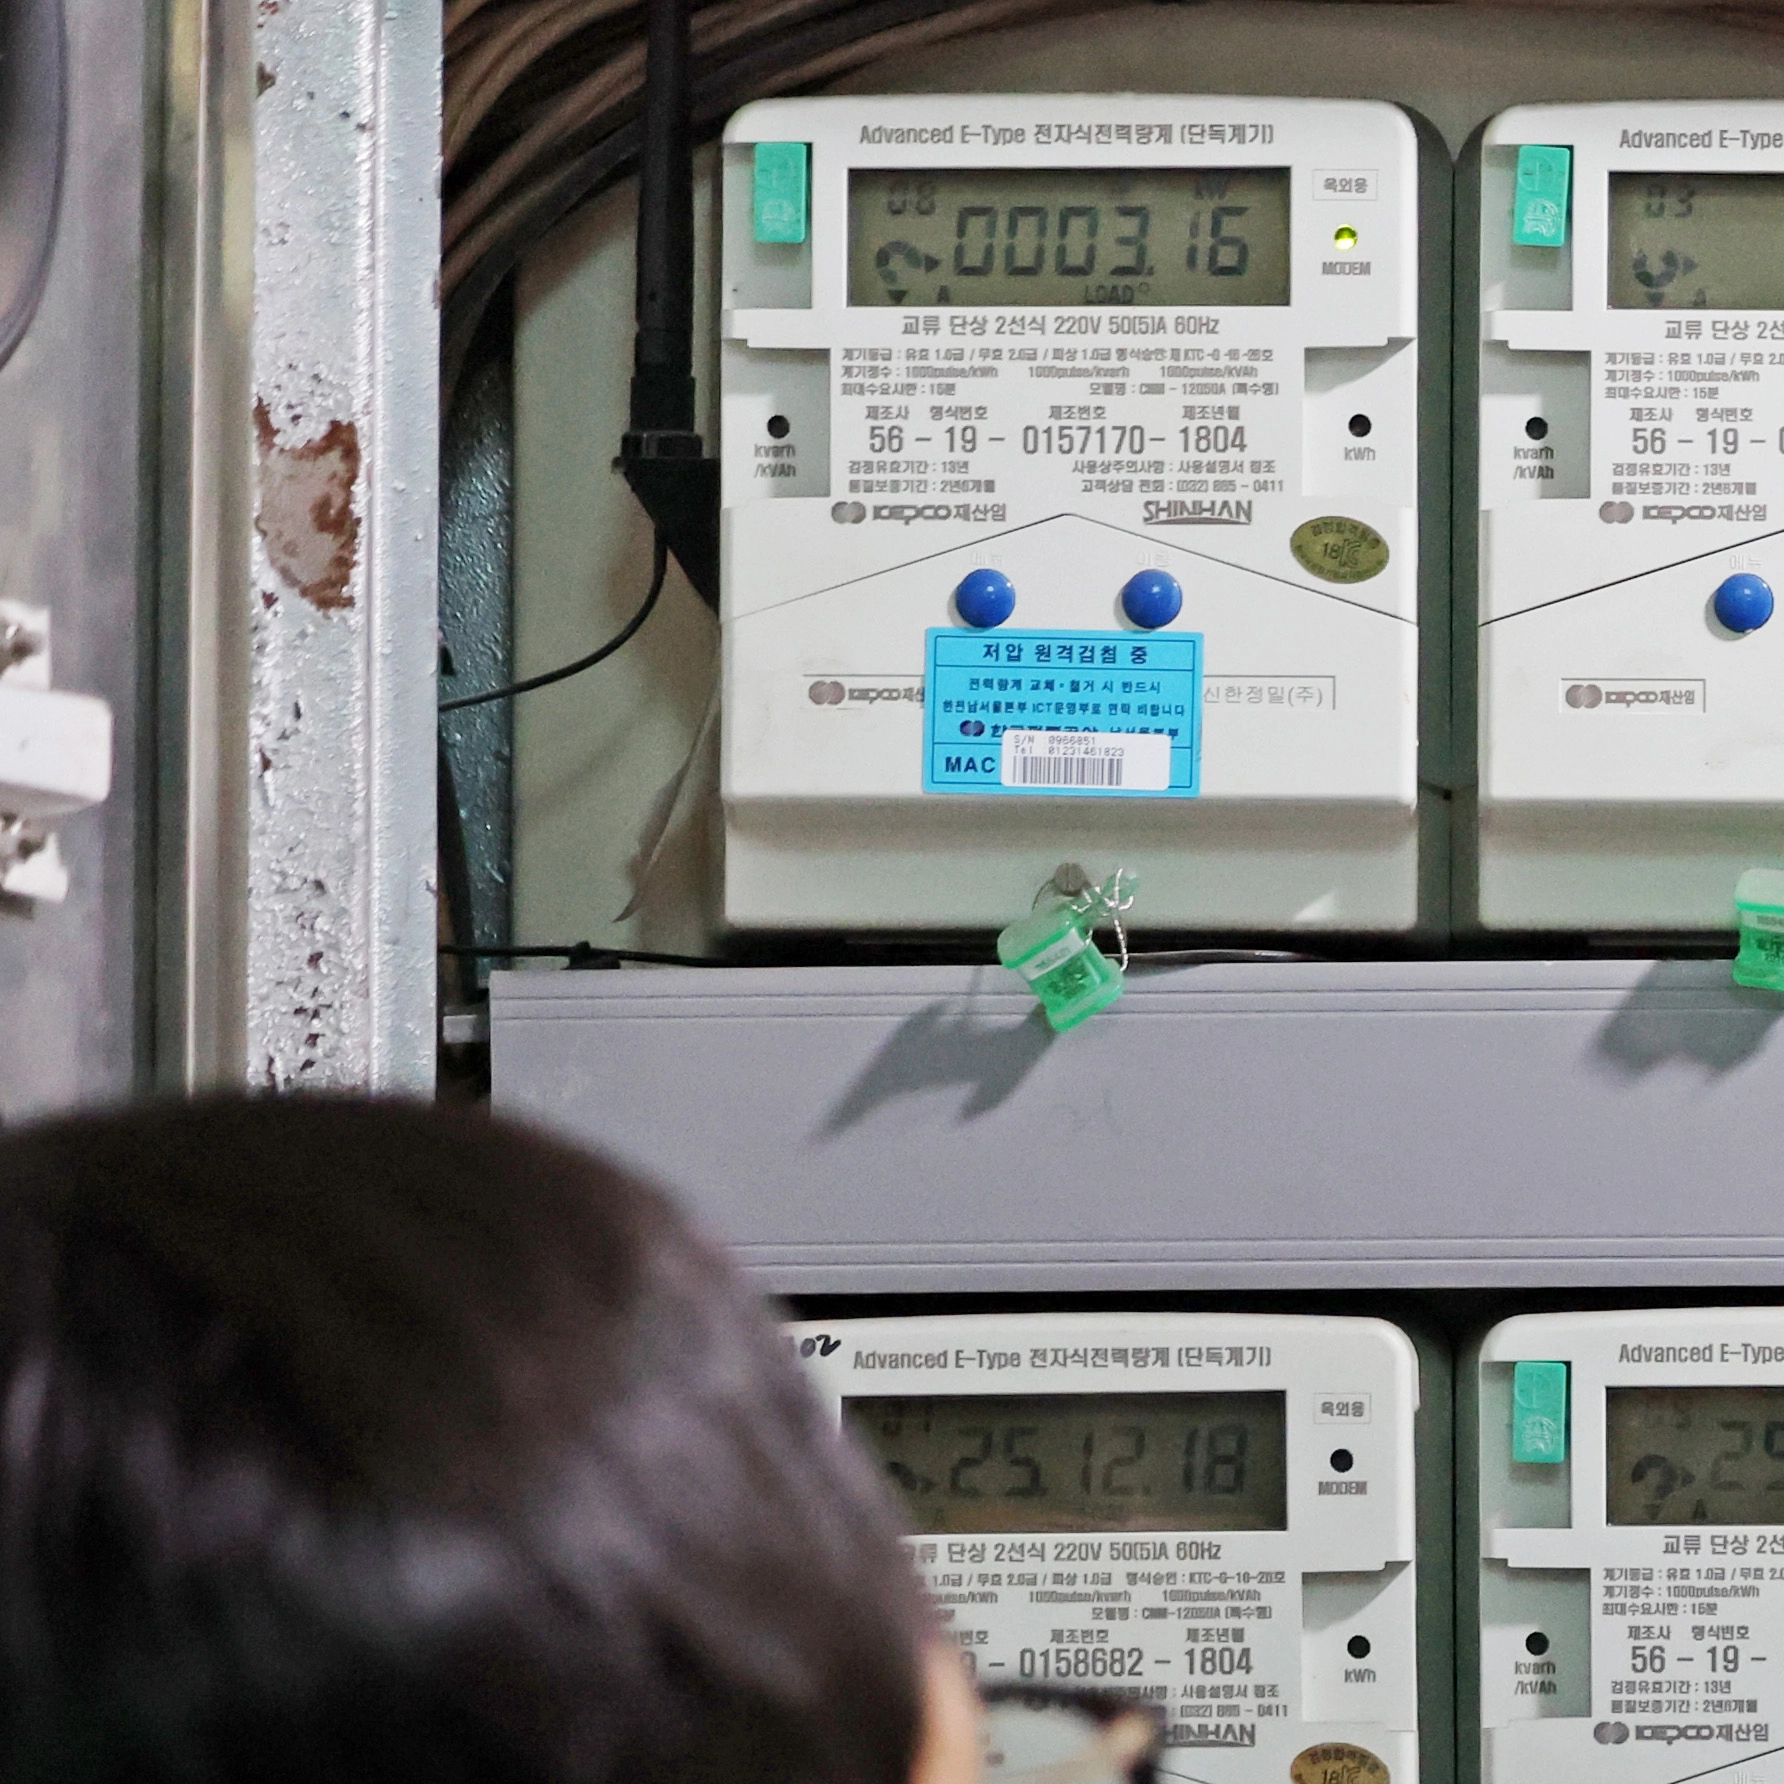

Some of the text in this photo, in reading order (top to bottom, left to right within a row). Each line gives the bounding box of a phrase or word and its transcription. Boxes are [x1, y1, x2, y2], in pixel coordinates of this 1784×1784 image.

[859, 124, 1025, 146] Advanced E-Type
[1619, 129, 1783, 150] Advanced E-Type
[954, 207, 1249, 276] 0003.16
[870, 425, 903, 453] 56
[945, 425, 977, 453] 19
[1179, 425, 1247, 453] 1804
[983, 642, 1148, 665] 저압 원격검침 중
[945, 756, 996, 773] MAC
[853, 1349, 1021, 1370] Advanced E-Type
[1619, 1343, 1784, 1364] Advanced E-Type
[1018, 1647, 1253, 1677] 0158682 1804
[1632, 1645, 1665, 1673] 56
[1707, 1645, 1739, 1673] 19
